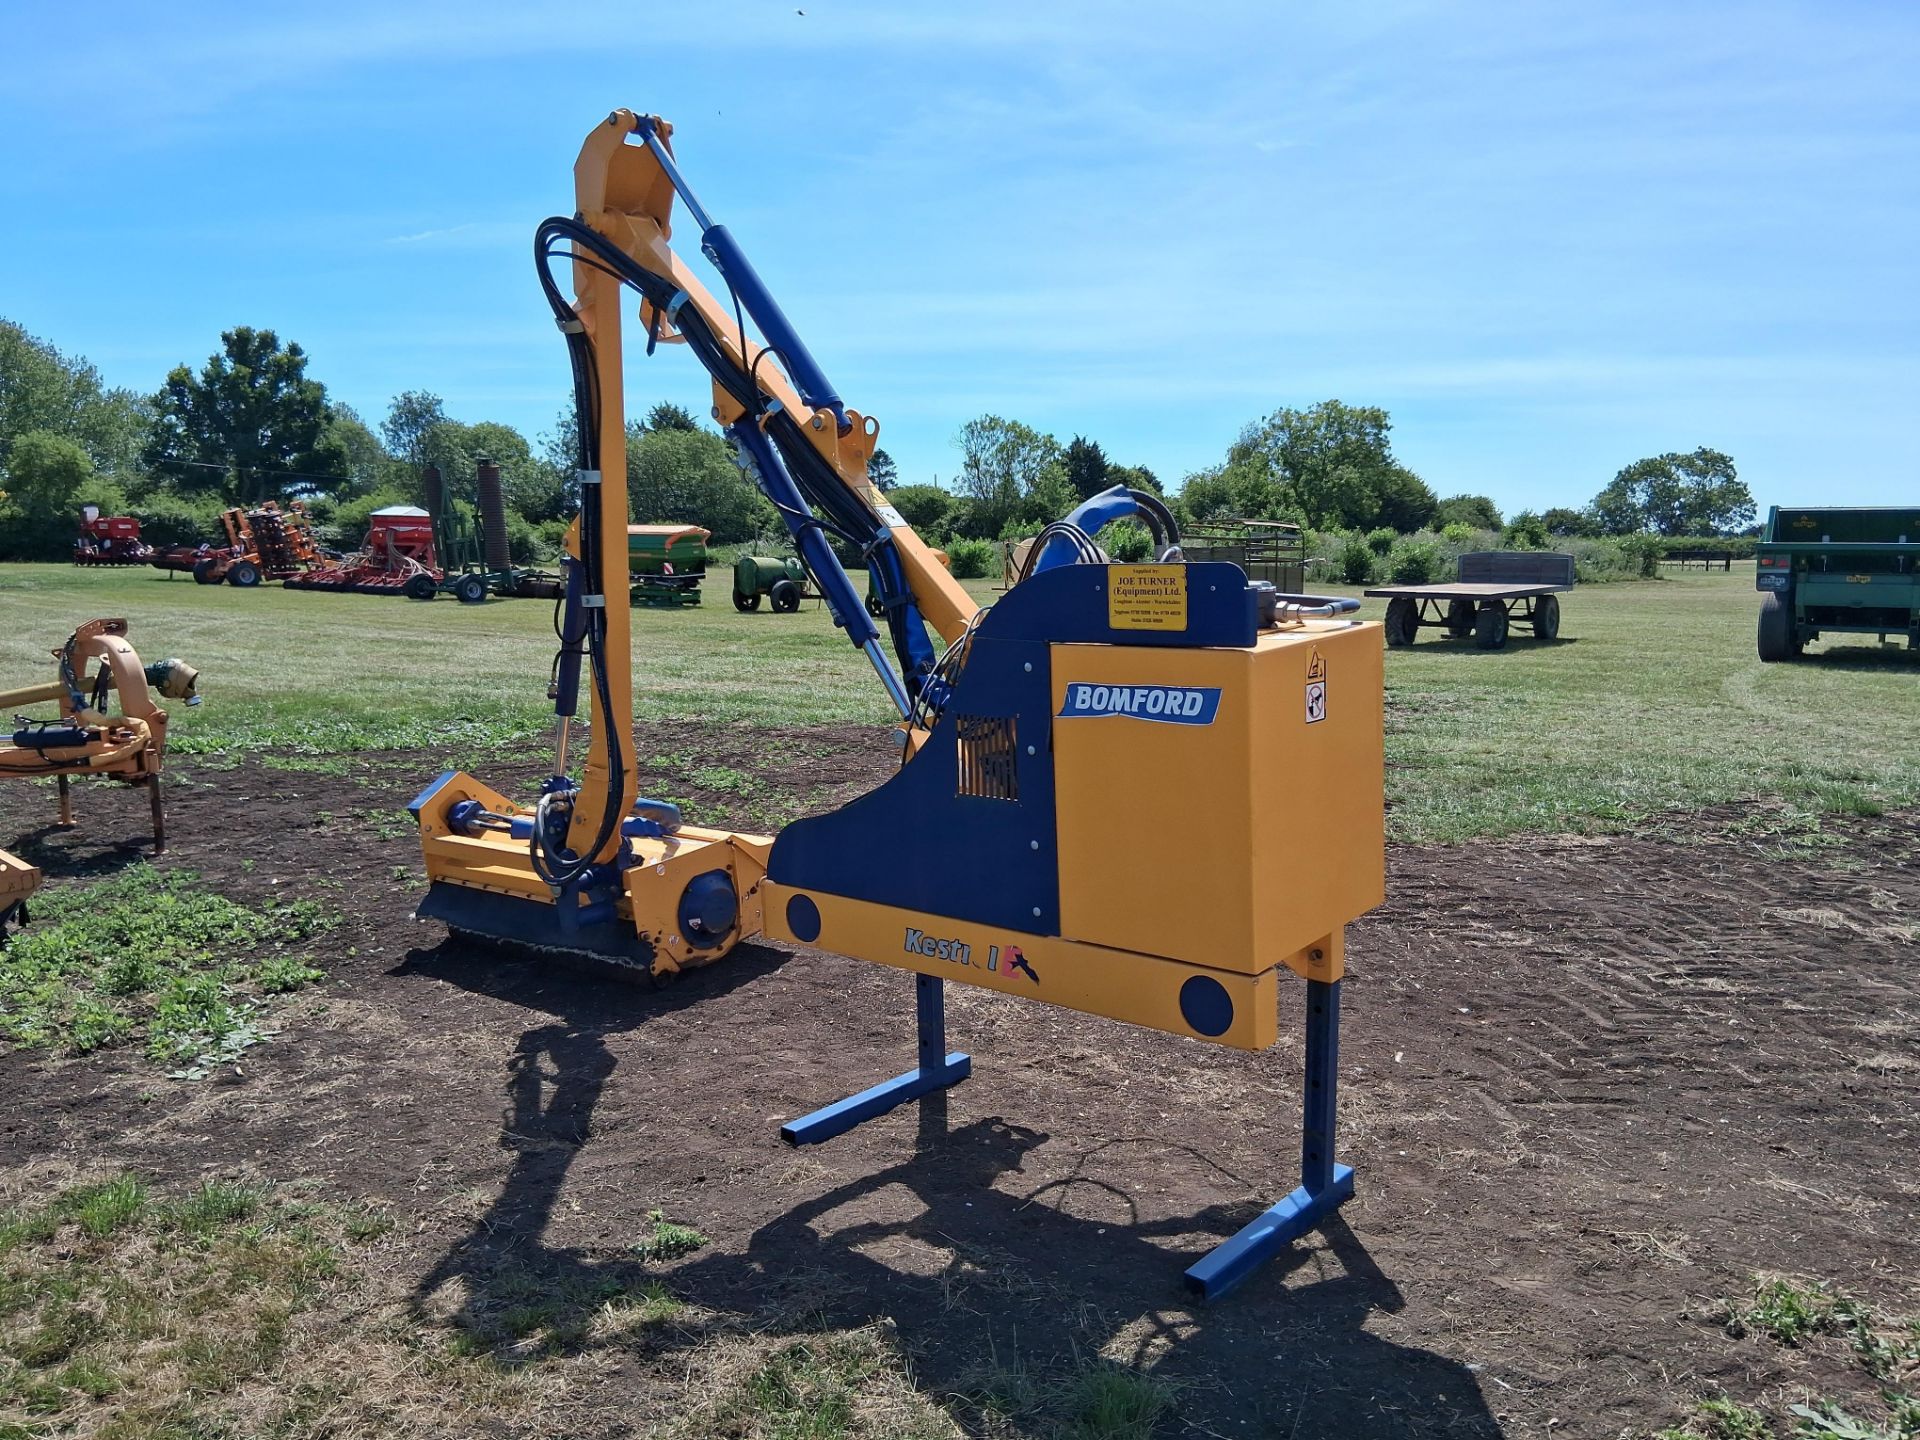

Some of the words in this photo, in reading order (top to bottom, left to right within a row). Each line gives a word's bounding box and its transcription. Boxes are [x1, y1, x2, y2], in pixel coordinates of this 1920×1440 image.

[1117, 577, 1135, 586] JOE
[1137, 577, 1176, 586] TURNER
[1113, 587, 1163, 597] (Equipment)
[1164, 587, 1181, 596] Ltd.
[1075, 686, 1204, 717] BOMFORD
